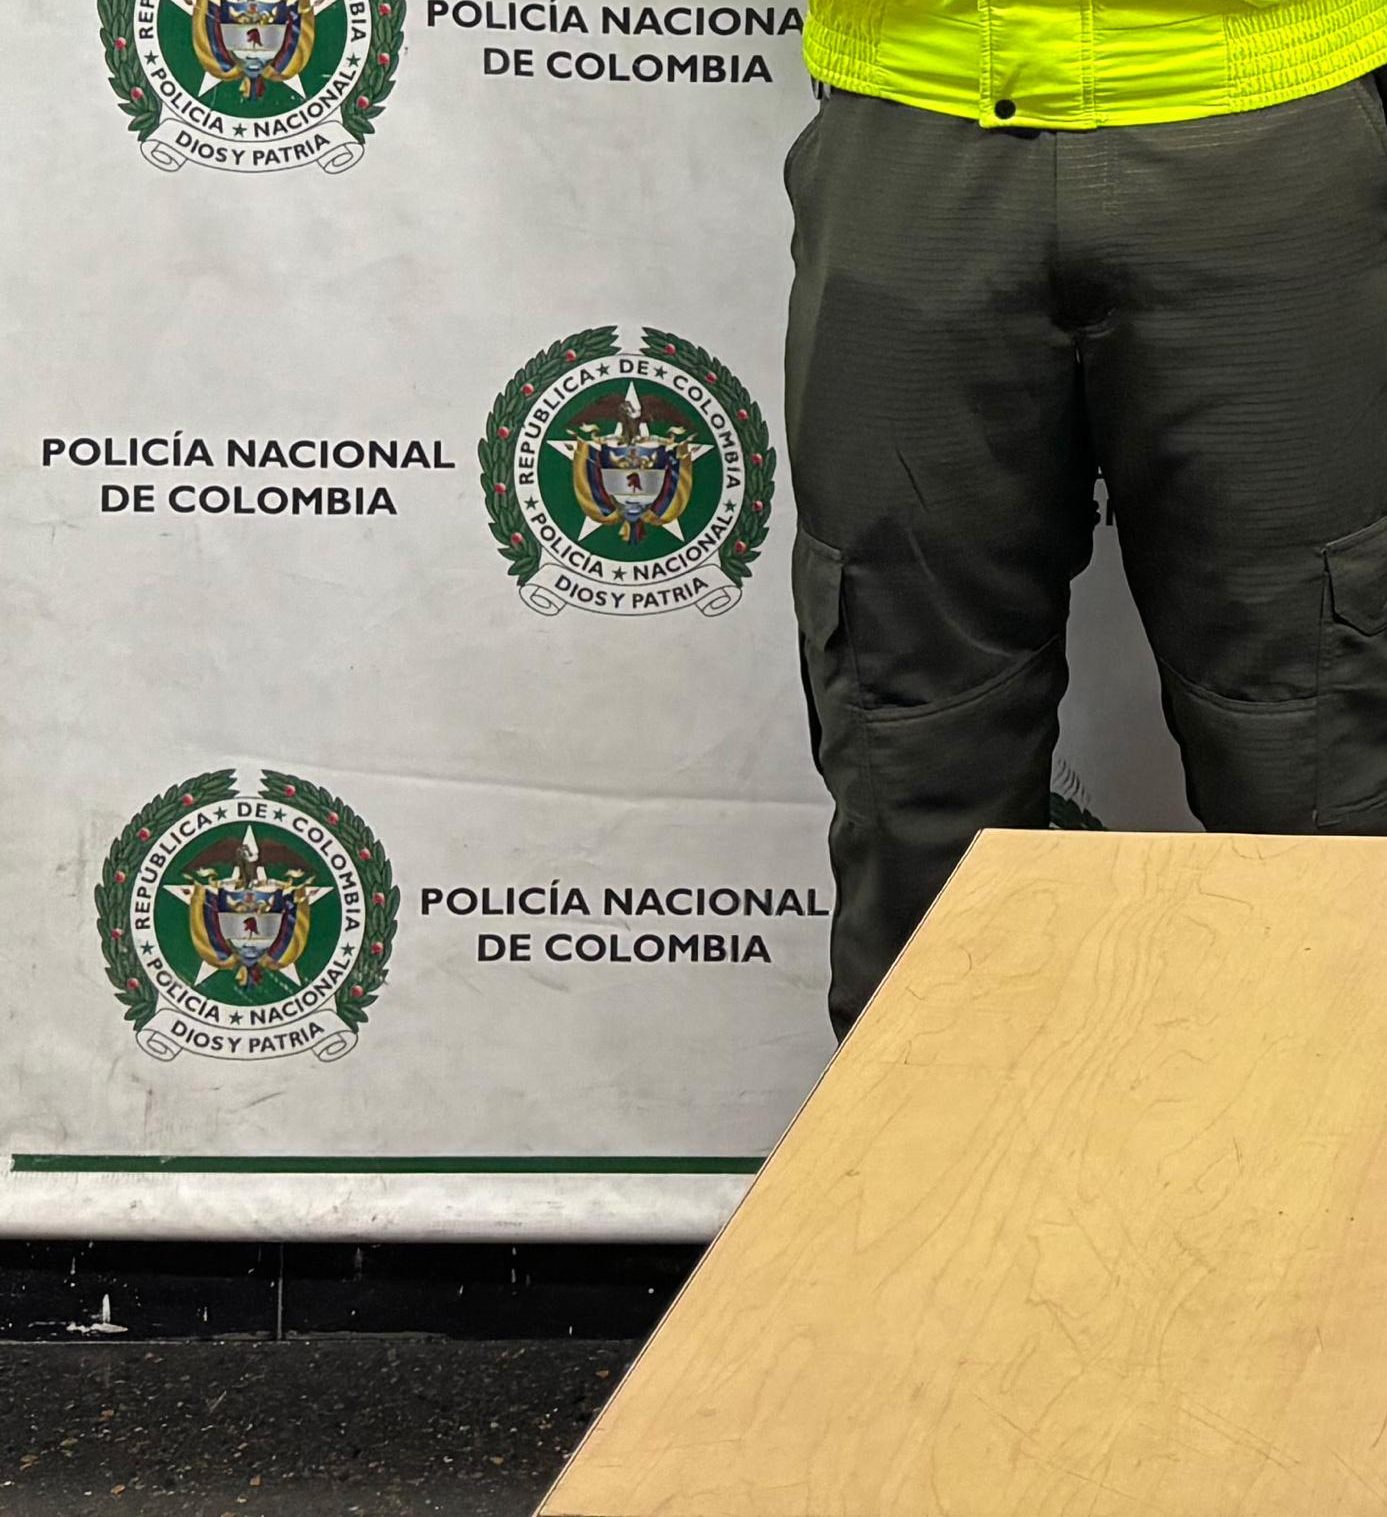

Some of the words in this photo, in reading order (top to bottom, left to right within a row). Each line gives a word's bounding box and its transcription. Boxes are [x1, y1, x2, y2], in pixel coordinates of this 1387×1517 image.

[602, 7, 803, 35] NACIONA
[484, 48, 533, 76] DE
[547, 51, 773, 83] COLOMBIA
[43, 431, 214, 466] POLICÍA
[228, 440, 455, 468] NACIONAL
[102, 485, 154, 512] DE
[169, 486, 397, 515] COLOMBIA
[238, 802, 267, 818] DE
[293, 817, 360, 932] COLOMBIA
[422, 879, 590, 915] POLICÍA
[604, 888, 829, 916] NACIONAL
[478, 934, 531, 961] DE
[545, 934, 771, 963] COLOMBIA
[250, 959, 350, 1025] NACIONAL
[171, 1020, 223, 1050] DIOS
[249, 1022, 324, 1053] PATRIA
